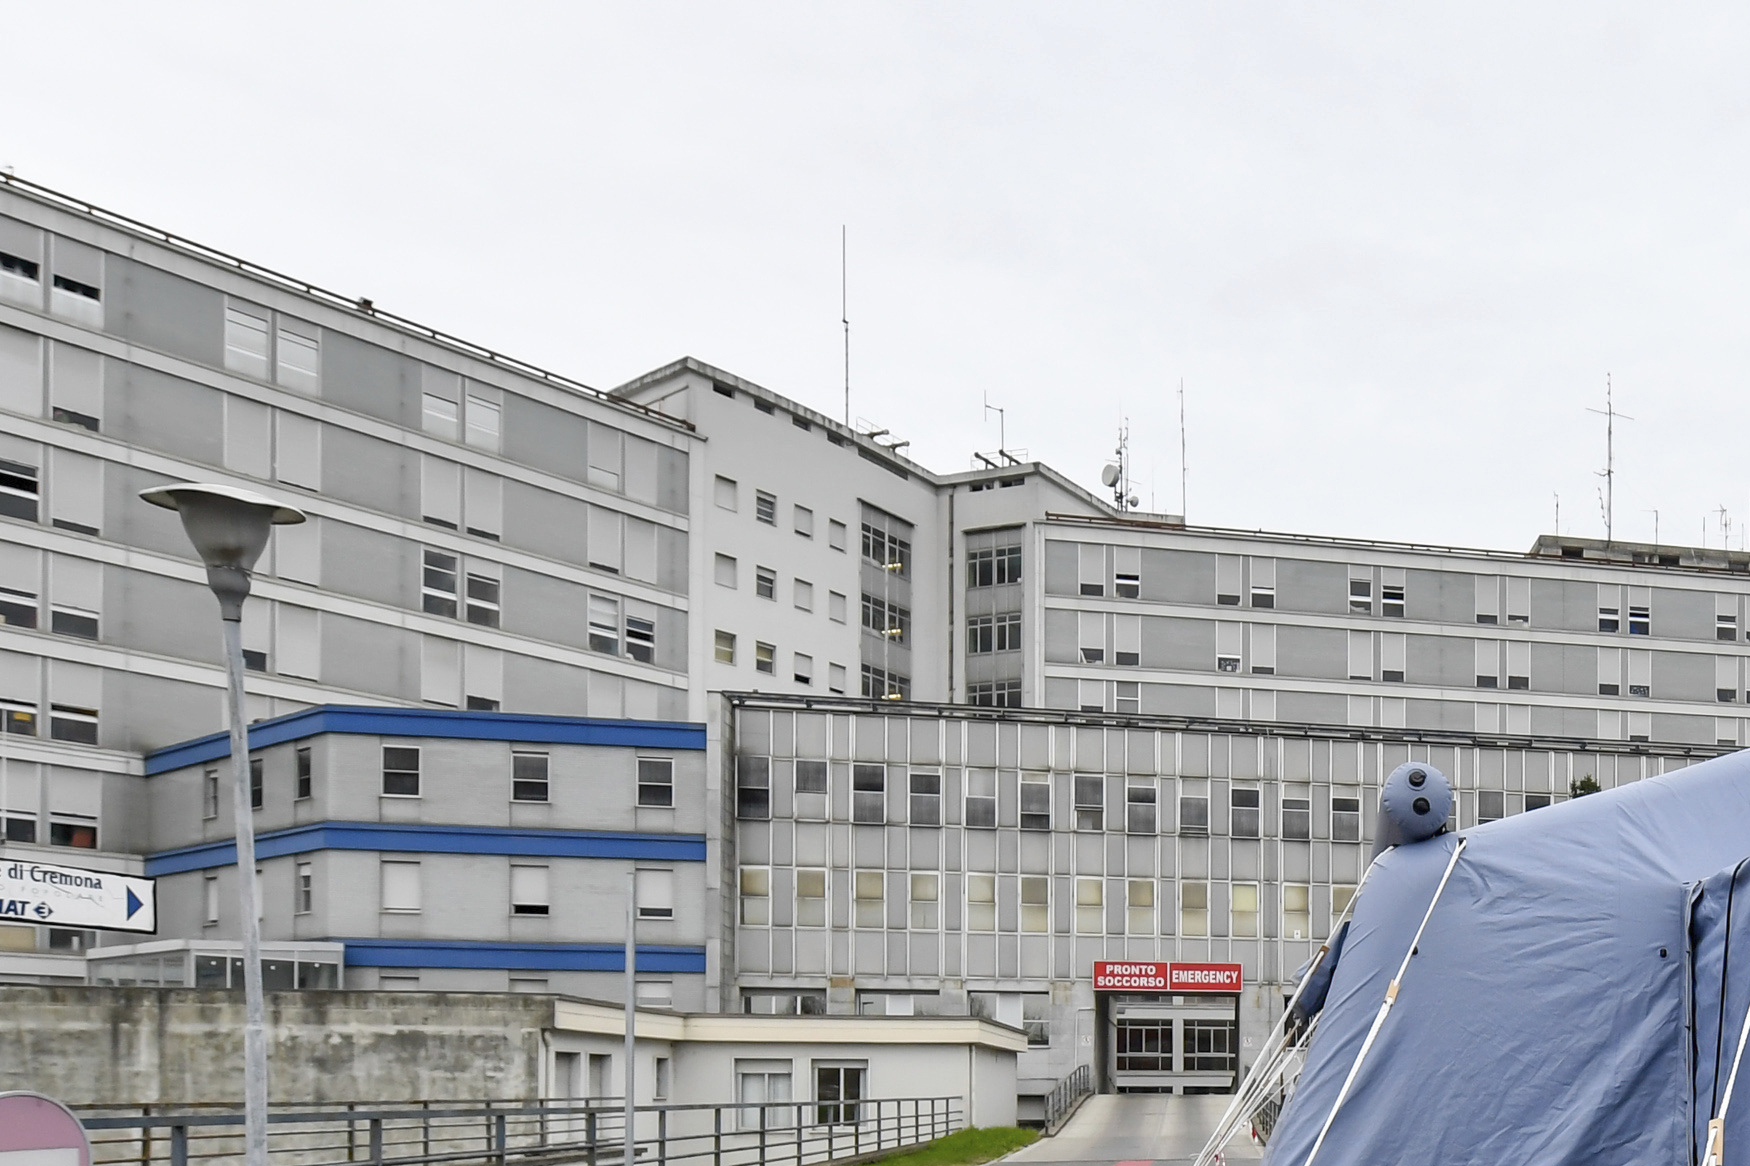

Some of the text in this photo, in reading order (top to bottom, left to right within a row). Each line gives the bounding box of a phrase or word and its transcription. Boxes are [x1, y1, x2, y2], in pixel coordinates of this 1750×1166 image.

[8, 863, 23, 880] di
[30, 866, 103, 889] Cremona
[1106, 965, 1156, 975] PRONTO
[1097, 976, 1165, 987] SOCCORSO
[1172, 970, 1239, 983] EMERGENCY
